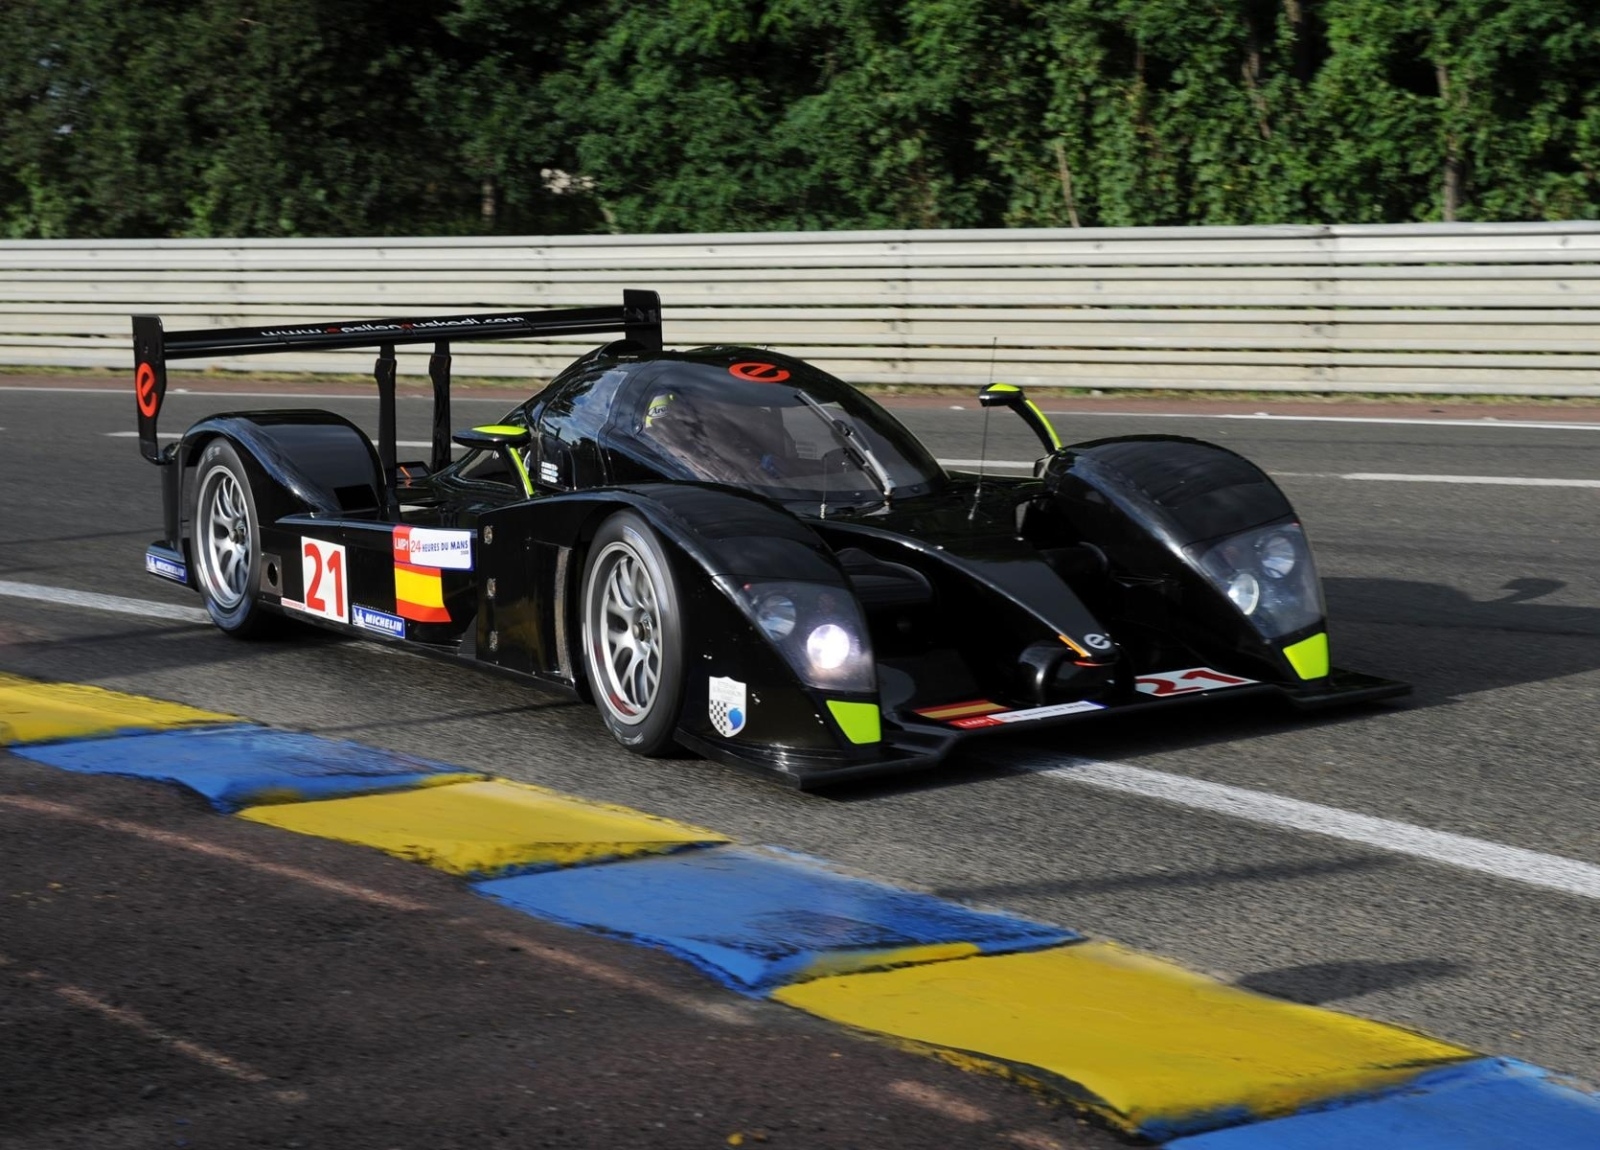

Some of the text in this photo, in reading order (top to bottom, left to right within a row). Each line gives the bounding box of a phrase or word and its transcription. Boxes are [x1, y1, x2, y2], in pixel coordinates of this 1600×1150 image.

[410, 540, 468, 552] 24 HEURES DU MANS
[304, 543, 344, 618] 21
[365, 613, 402, 632] MICHELIN
[1136, 670, 1246, 694] 21
